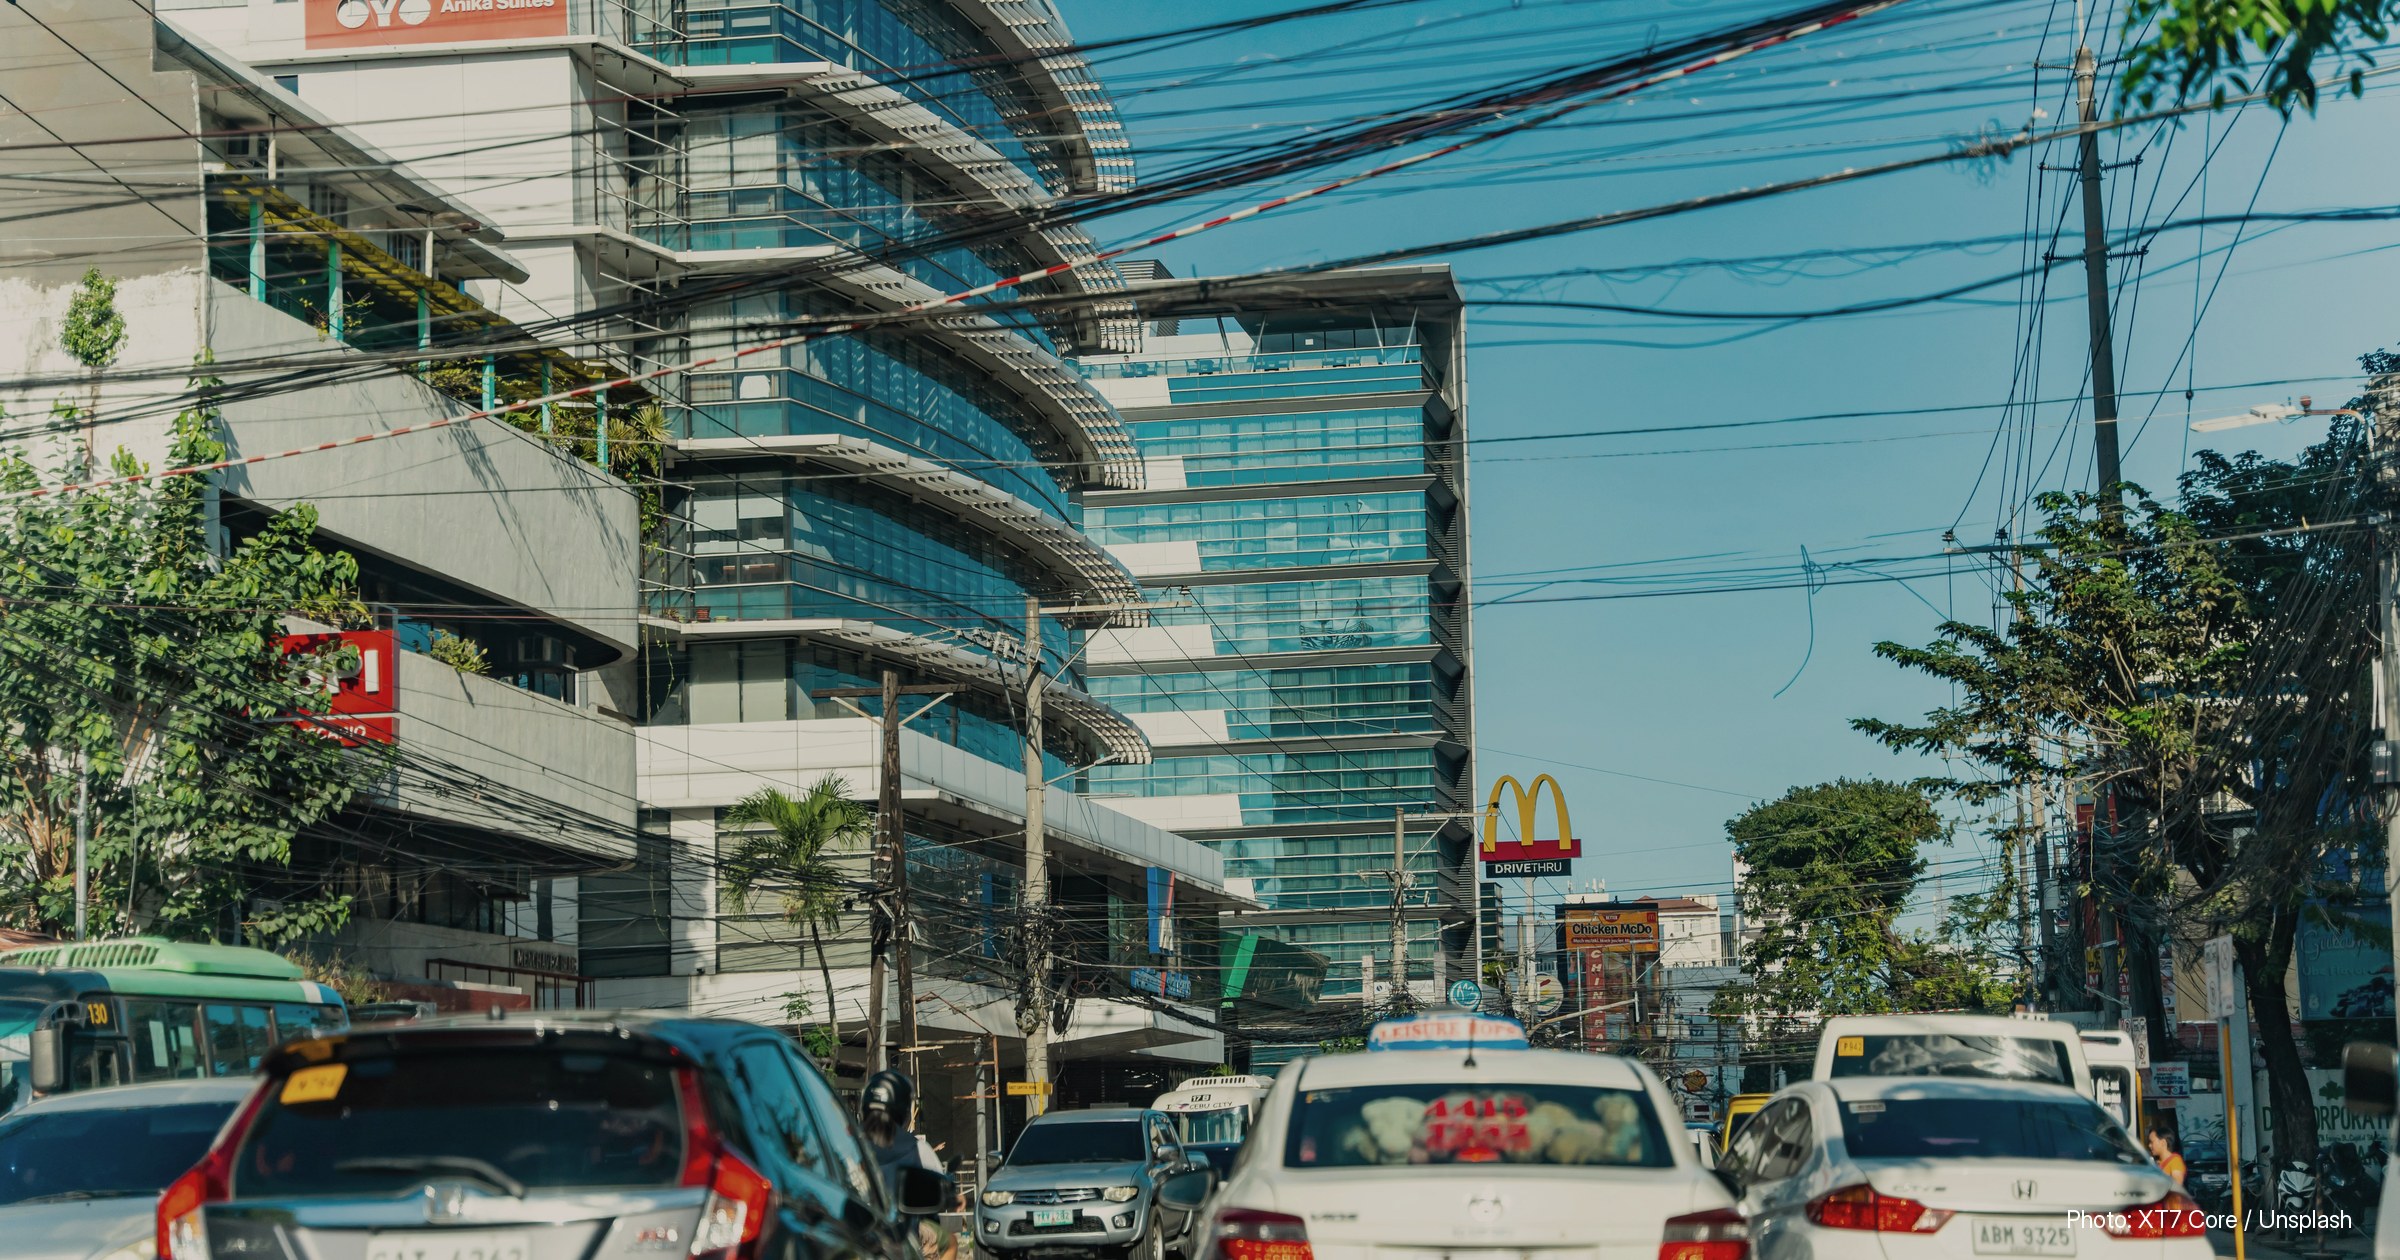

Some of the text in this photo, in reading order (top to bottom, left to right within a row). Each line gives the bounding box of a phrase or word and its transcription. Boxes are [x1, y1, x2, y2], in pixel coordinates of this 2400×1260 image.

[336, 0, 431, 29] OYO
[440, 0, 493, 15] Anika
[1495, 862, 1562, 874] DRIVETHRU
[1572, 923, 1652, 935] Chicken McDo
[88, 1003, 108, 1025] 130
[1213, 1101, 1233, 1109] CITY
[1980, 1223, 2070, 1246] ABM 9325
